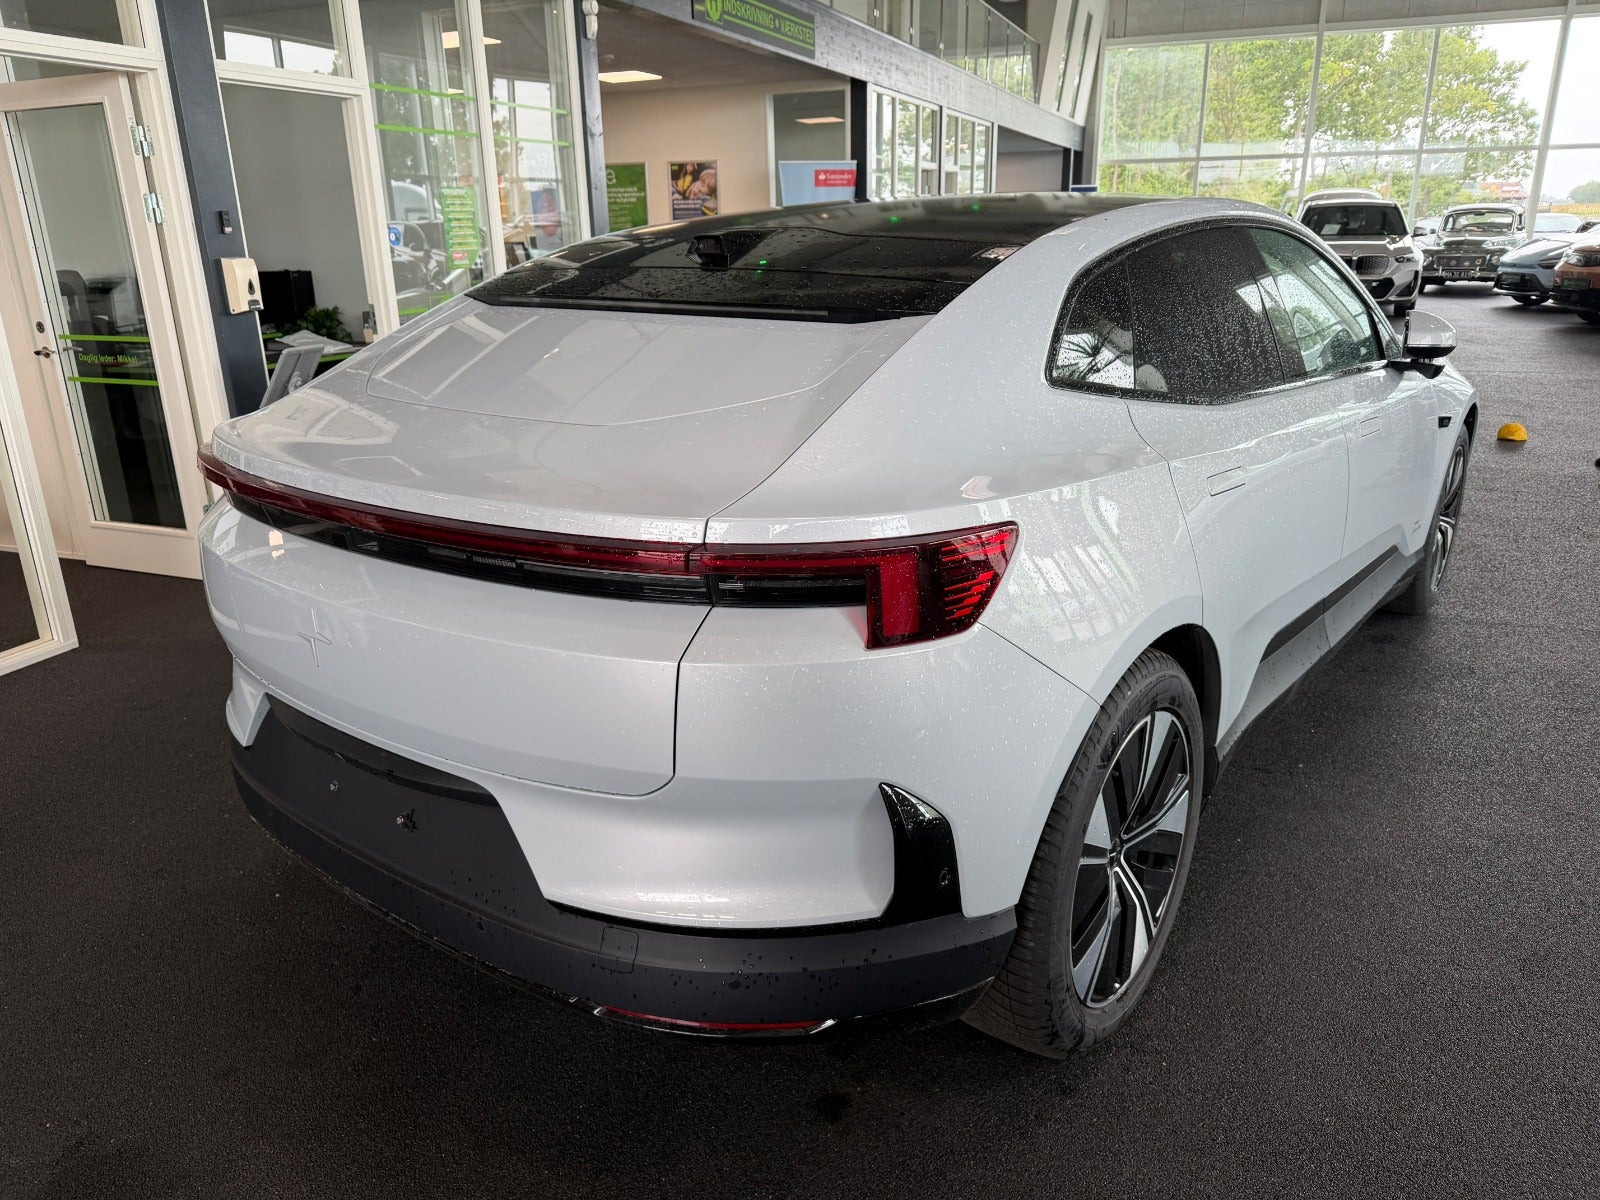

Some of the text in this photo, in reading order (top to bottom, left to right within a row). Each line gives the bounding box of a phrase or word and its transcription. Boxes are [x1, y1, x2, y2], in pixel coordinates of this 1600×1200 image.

[723, 0, 814, 44] INDSKRIVNING VÆRKSTED
[78, 353, 137, 364] Daglig leder: Mikkel
